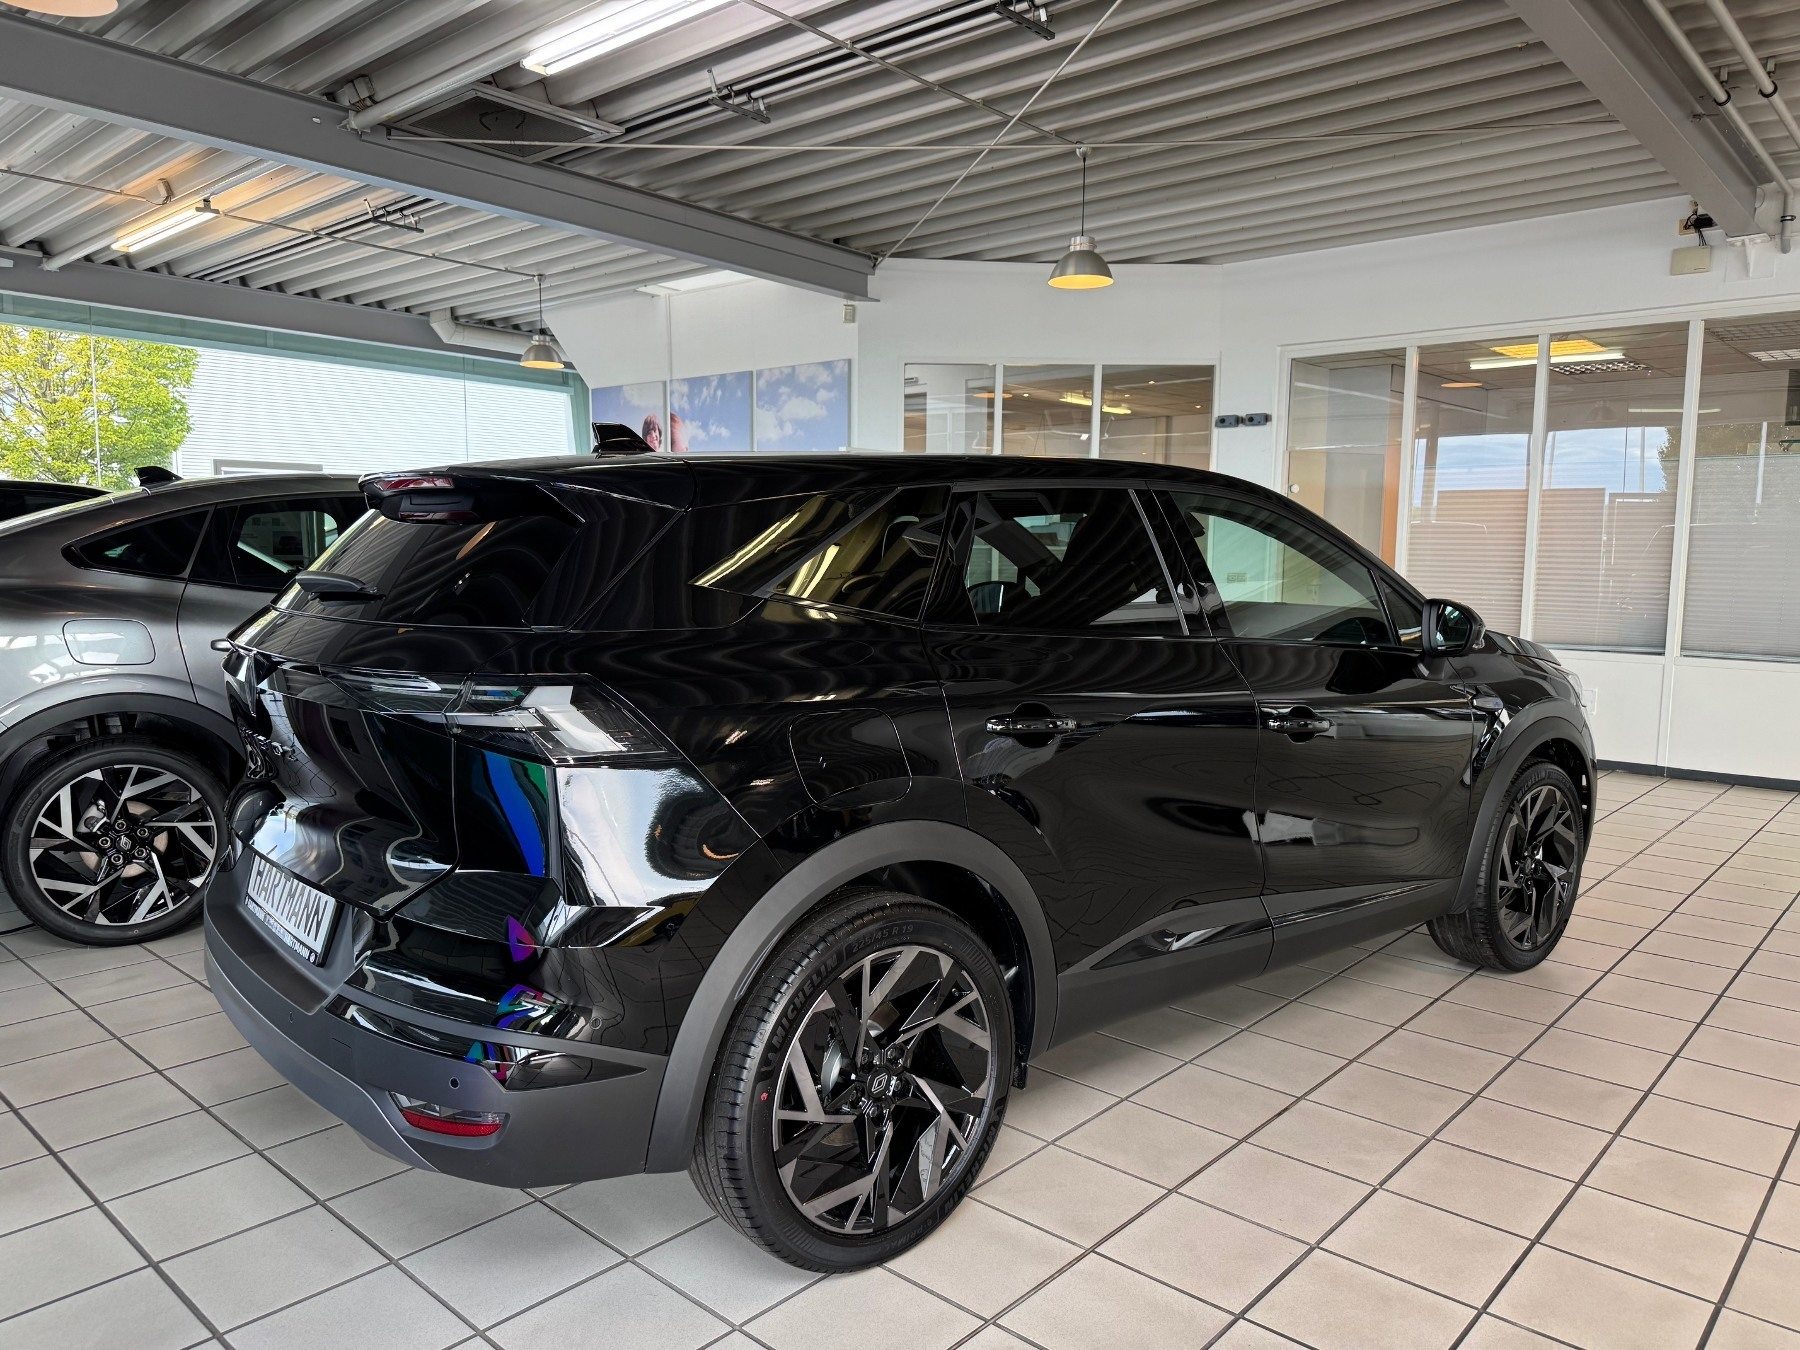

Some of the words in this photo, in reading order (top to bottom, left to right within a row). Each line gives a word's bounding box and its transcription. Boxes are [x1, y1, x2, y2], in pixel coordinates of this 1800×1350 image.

[252, 856, 328, 942] HARTMANN
[853, 929, 889, 953] 225/45
[892, 927, 899, 935] R
[902, 924, 914, 933] 19
[772, 954, 838, 1048] MICHELIN
[944, 1125, 996, 1216] MICHELIN
